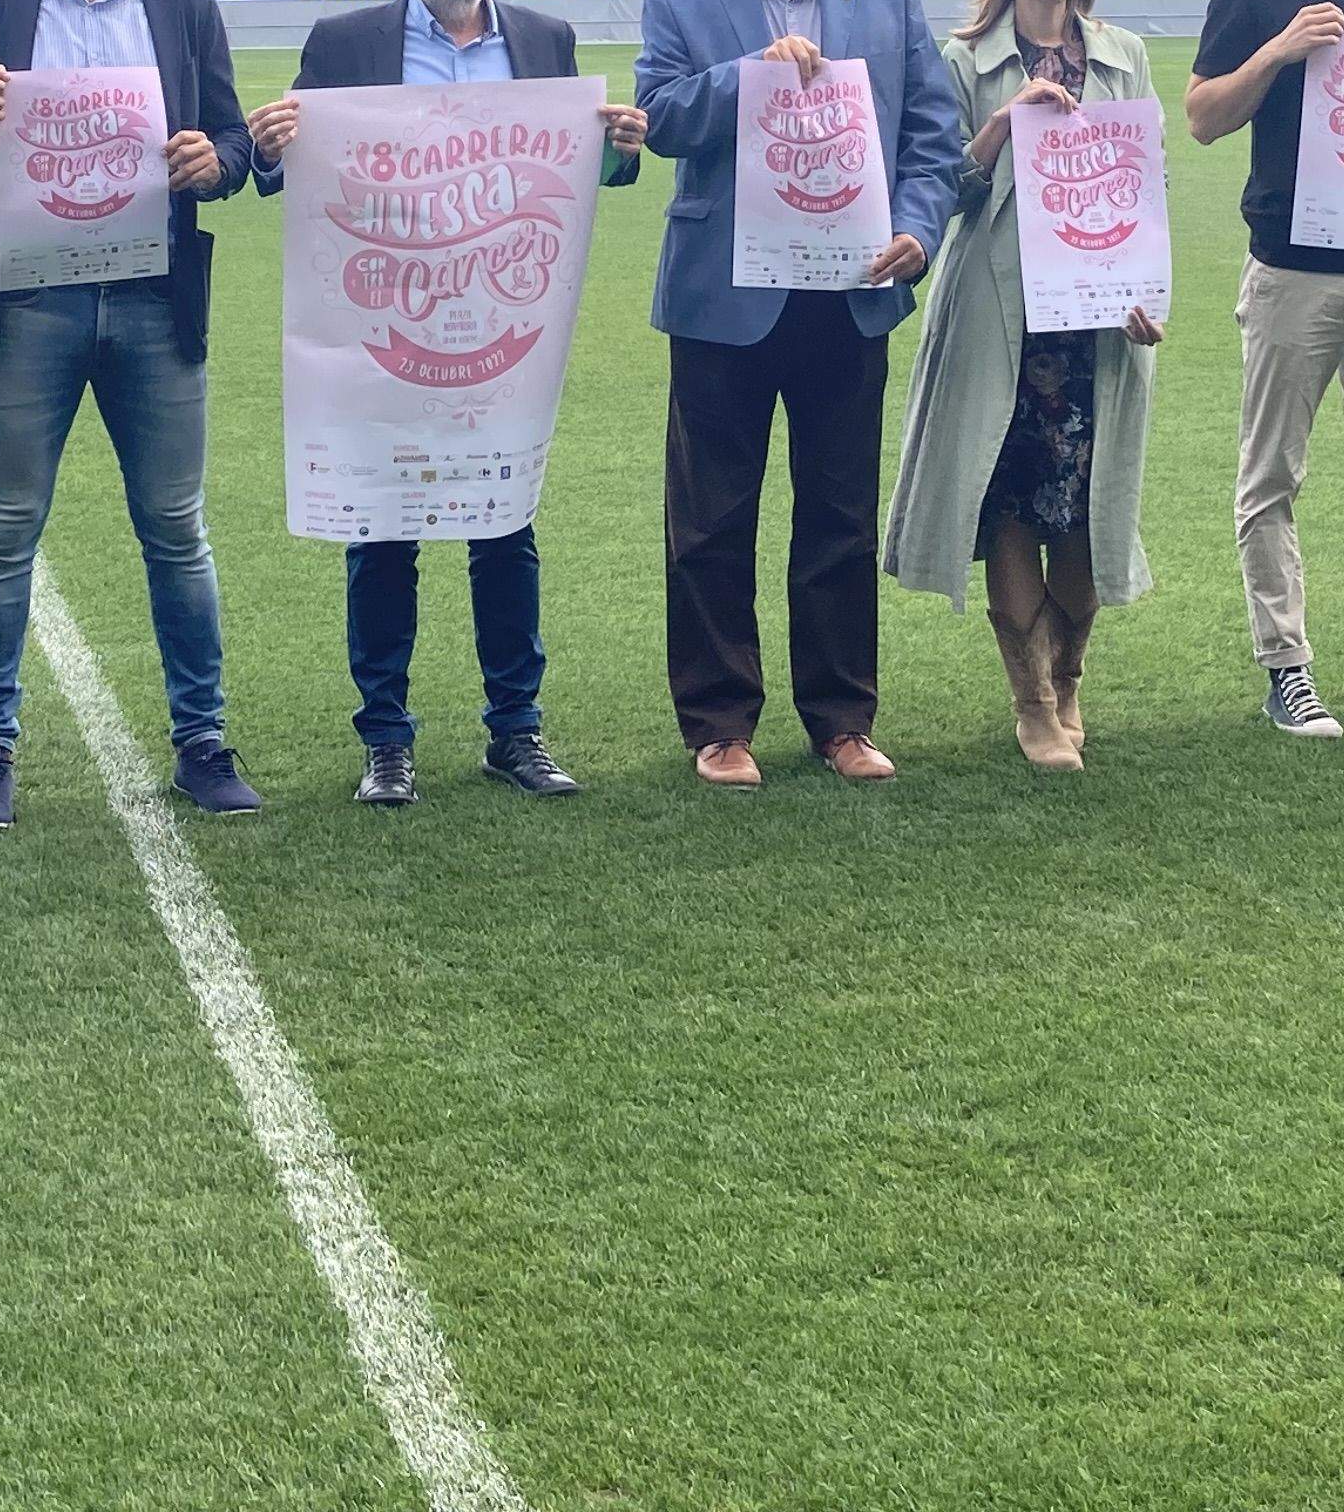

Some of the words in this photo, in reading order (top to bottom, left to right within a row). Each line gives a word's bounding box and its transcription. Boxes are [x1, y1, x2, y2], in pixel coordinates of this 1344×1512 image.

[56, 88, 138, 117] CARRERA
[797, 83, 857, 110] CARRERA
[1063, 121, 1136, 149] CARRERA
[401, 124, 551, 180] CARRERA
[357, 256, 387, 272] CON
[393, 221, 560, 322] Cáncer
[418, 364, 474, 381] OCTUBRE
[476, 348, 507, 375] 2022
